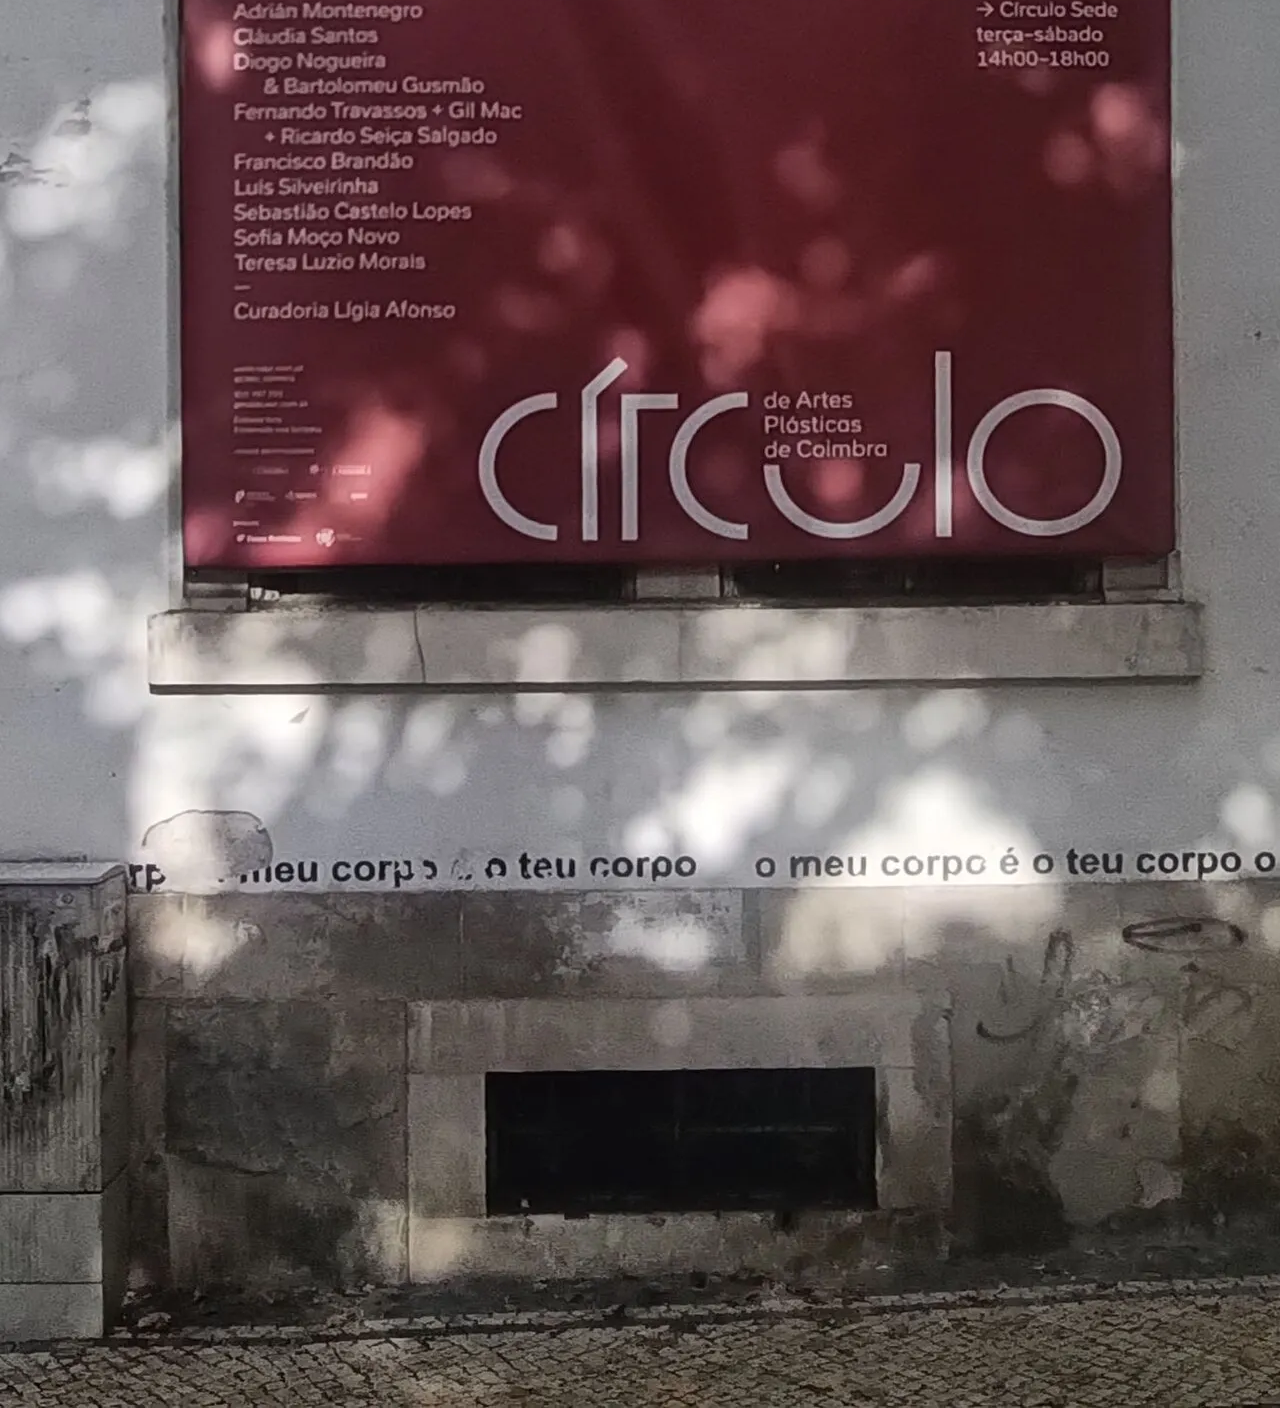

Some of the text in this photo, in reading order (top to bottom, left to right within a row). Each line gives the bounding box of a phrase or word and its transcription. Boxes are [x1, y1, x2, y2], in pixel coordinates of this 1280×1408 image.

[232, 1, 424, 23] Adrián Montenegro
[999, 0, 1119, 18] Círculo Sede
[233, 25, 379, 47] Cláudia Santos
[233, 50, 387, 72] Diogo Nogueira
[263, 75, 485, 95] & Bartolomeu Gusmão
[233, 102, 328, 121] Fernando
[329, 100, 428, 120] Travassos
[447, 100, 476, 120] Gil
[480, 100, 523, 120] Mac
[280, 126, 357, 146] Ricardo
[359, 125, 414, 148] Seiça
[416, 124, 498, 148] Salgado
[233, 150, 414, 172] Francisco Brandão
[277, 176, 379, 197] Silveirinha
[233, 200, 473, 222] Sebastião Castelo Lopes
[233, 226, 401, 249] Sofia Moço Novo
[234, 252, 298, 272] Teresa
[358, 251, 426, 271] Morais
[233, 301, 330, 320] Curadoria
[384, 299, 456, 319] Afonso
[763, 390, 853, 410] de Artes
[764, 414, 863, 435] Plásticas
[763, 438, 888, 459] de Coimbra
[519, 852, 576, 880] teu
[590, 855, 697, 883] corpo
[754, 855, 776, 878] o
[789, 854, 868, 878] meu
[880, 853, 987, 882] corpo
[999, 846, 1020, 876] é
[1032, 852, 1055, 875] o
[1066, 848, 1124, 875] teu
[1135, 849, 1242, 880] corpo
[1254, 849, 1277, 873] o
